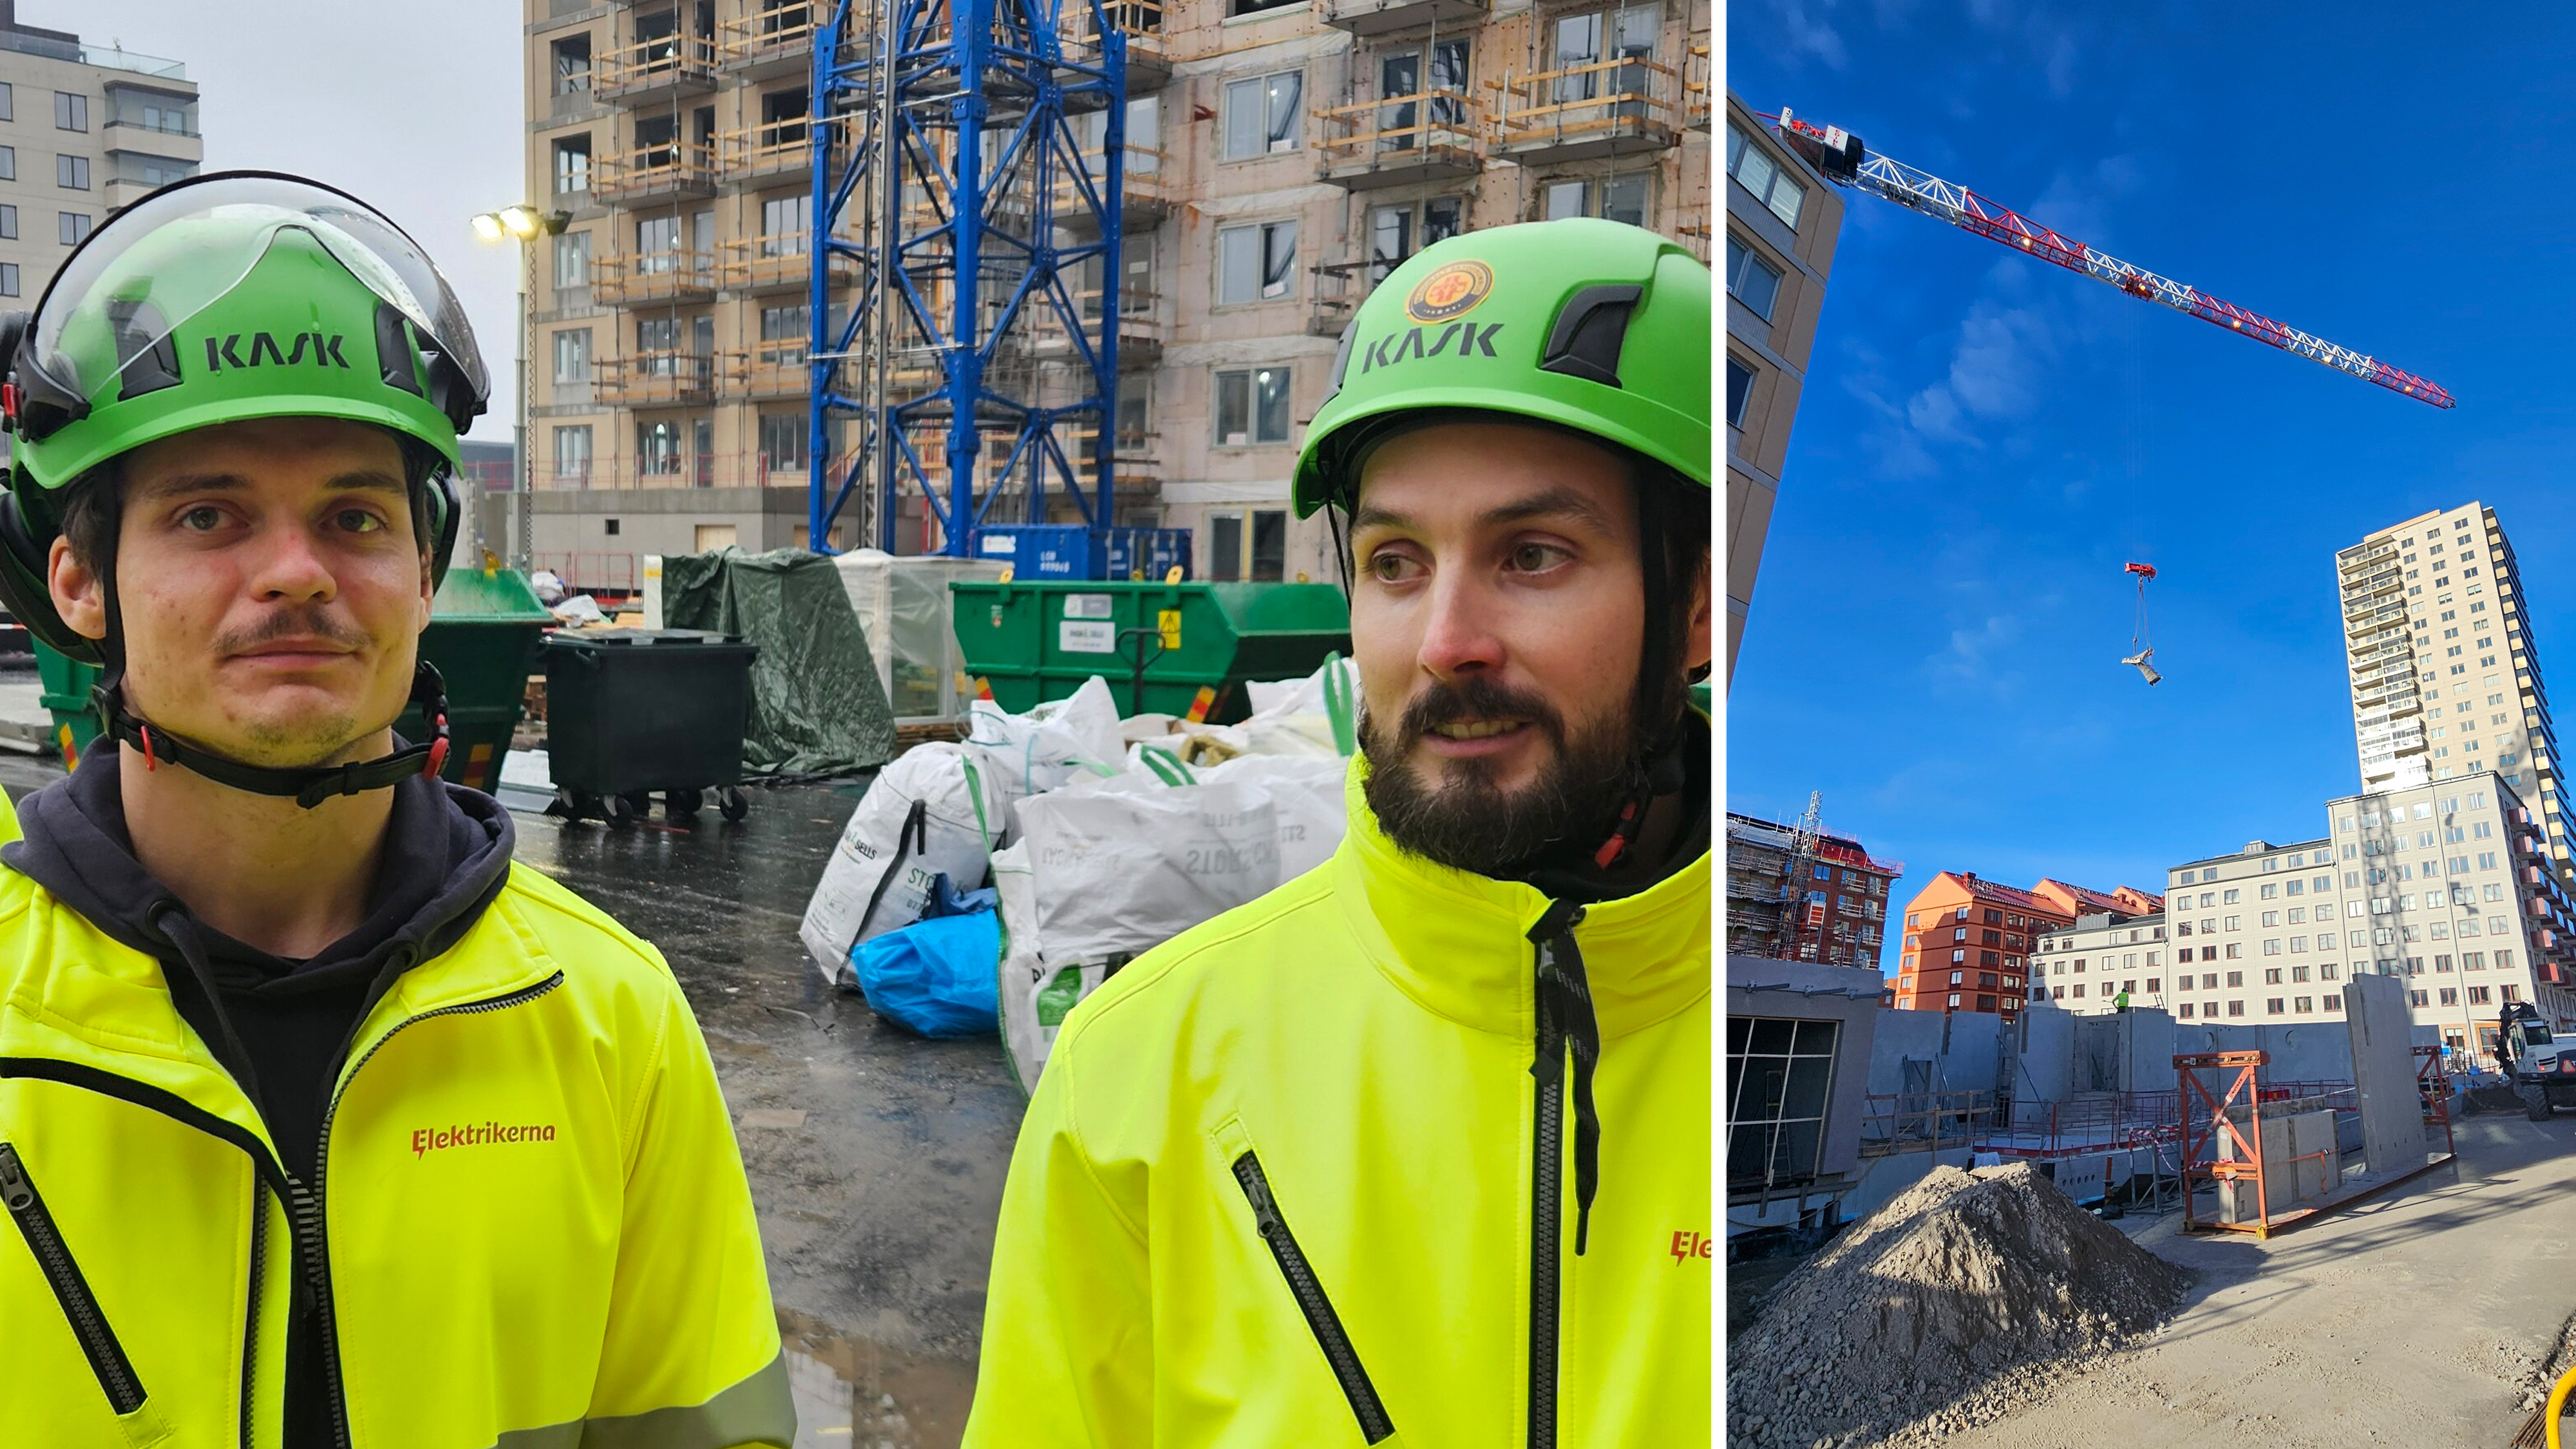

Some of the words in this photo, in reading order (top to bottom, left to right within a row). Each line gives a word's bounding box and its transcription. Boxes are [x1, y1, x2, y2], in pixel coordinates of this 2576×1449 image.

[205, 332, 350, 372] KASK
[1362, 323, 1504, 375] KASK
[855, 839, 877, 860] SELLS
[412, 1121, 556, 1160] Elektrikerna
[1671, 1231, 1711, 1267] Ele
